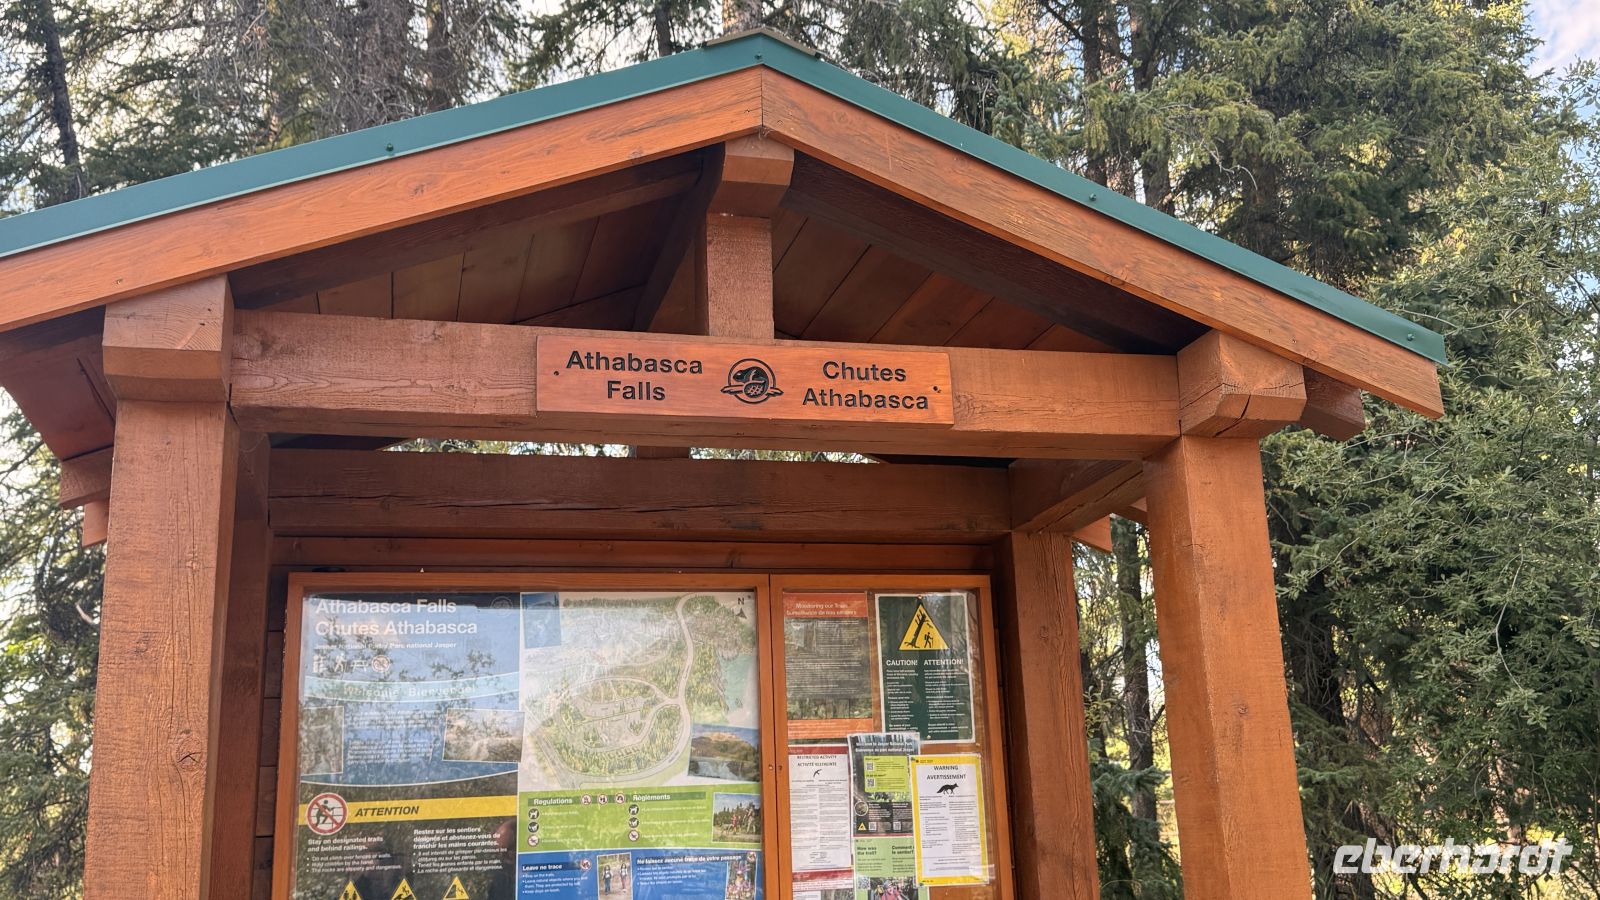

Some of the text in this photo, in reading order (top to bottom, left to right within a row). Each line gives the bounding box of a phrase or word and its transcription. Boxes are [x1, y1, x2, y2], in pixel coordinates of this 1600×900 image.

[566, 350, 702, 375] Athabasca
[823, 361, 907, 382] Chutes
[607, 380, 666, 400] Falls
[802, 388, 929, 410] Athabasca
[315, 598, 456, 614] Athabasca Falls
[315, 620, 478, 636] Chutes Athabasca
[355, 806, 420, 817] ATTENTION
